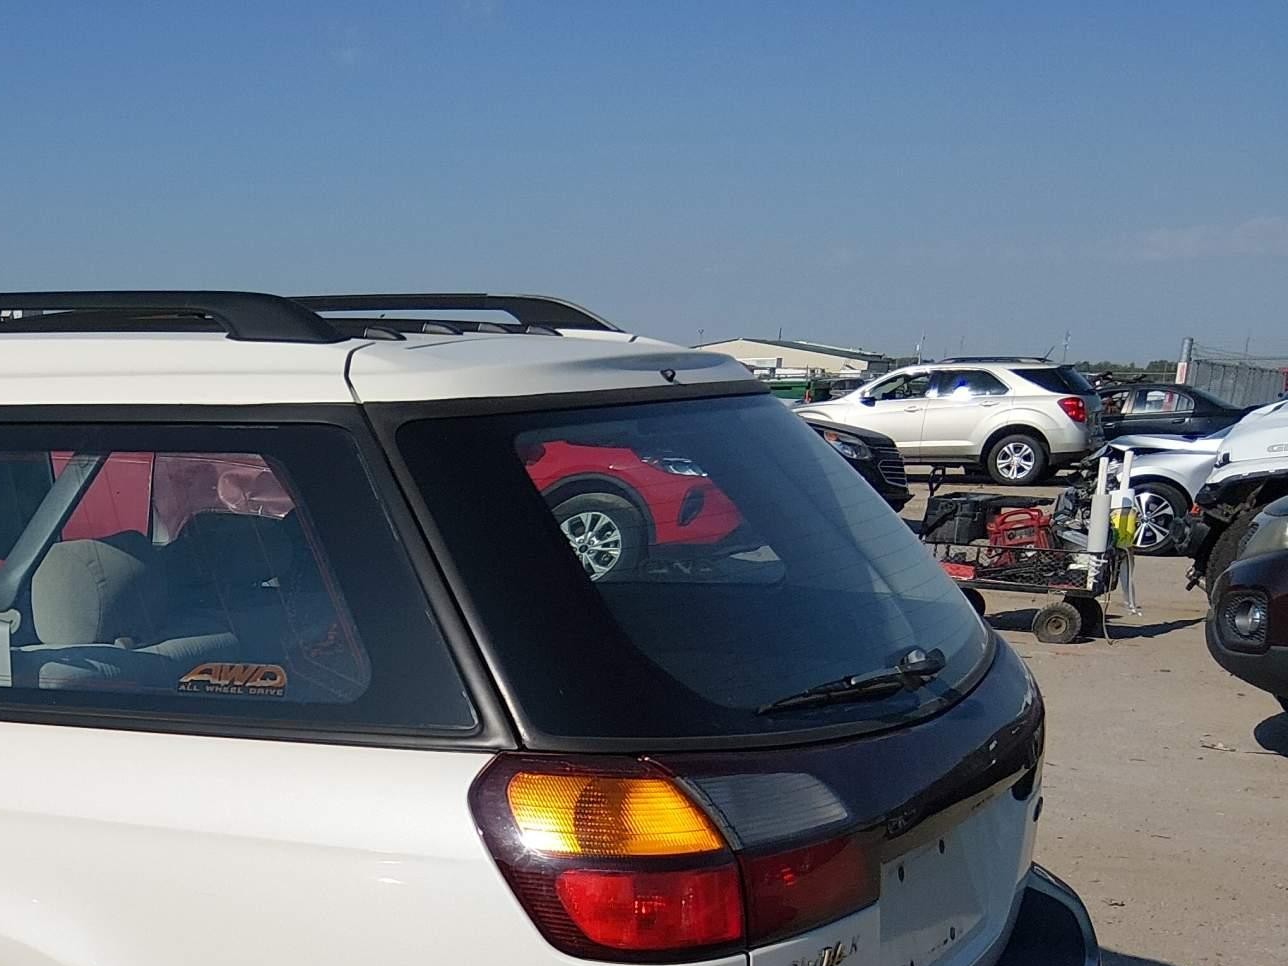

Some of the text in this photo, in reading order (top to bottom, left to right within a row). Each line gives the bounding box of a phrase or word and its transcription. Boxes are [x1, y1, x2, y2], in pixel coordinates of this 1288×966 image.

[179, 663, 287, 689] AWD
[178, 683, 285, 696] ALL WHEEL DRIVE
